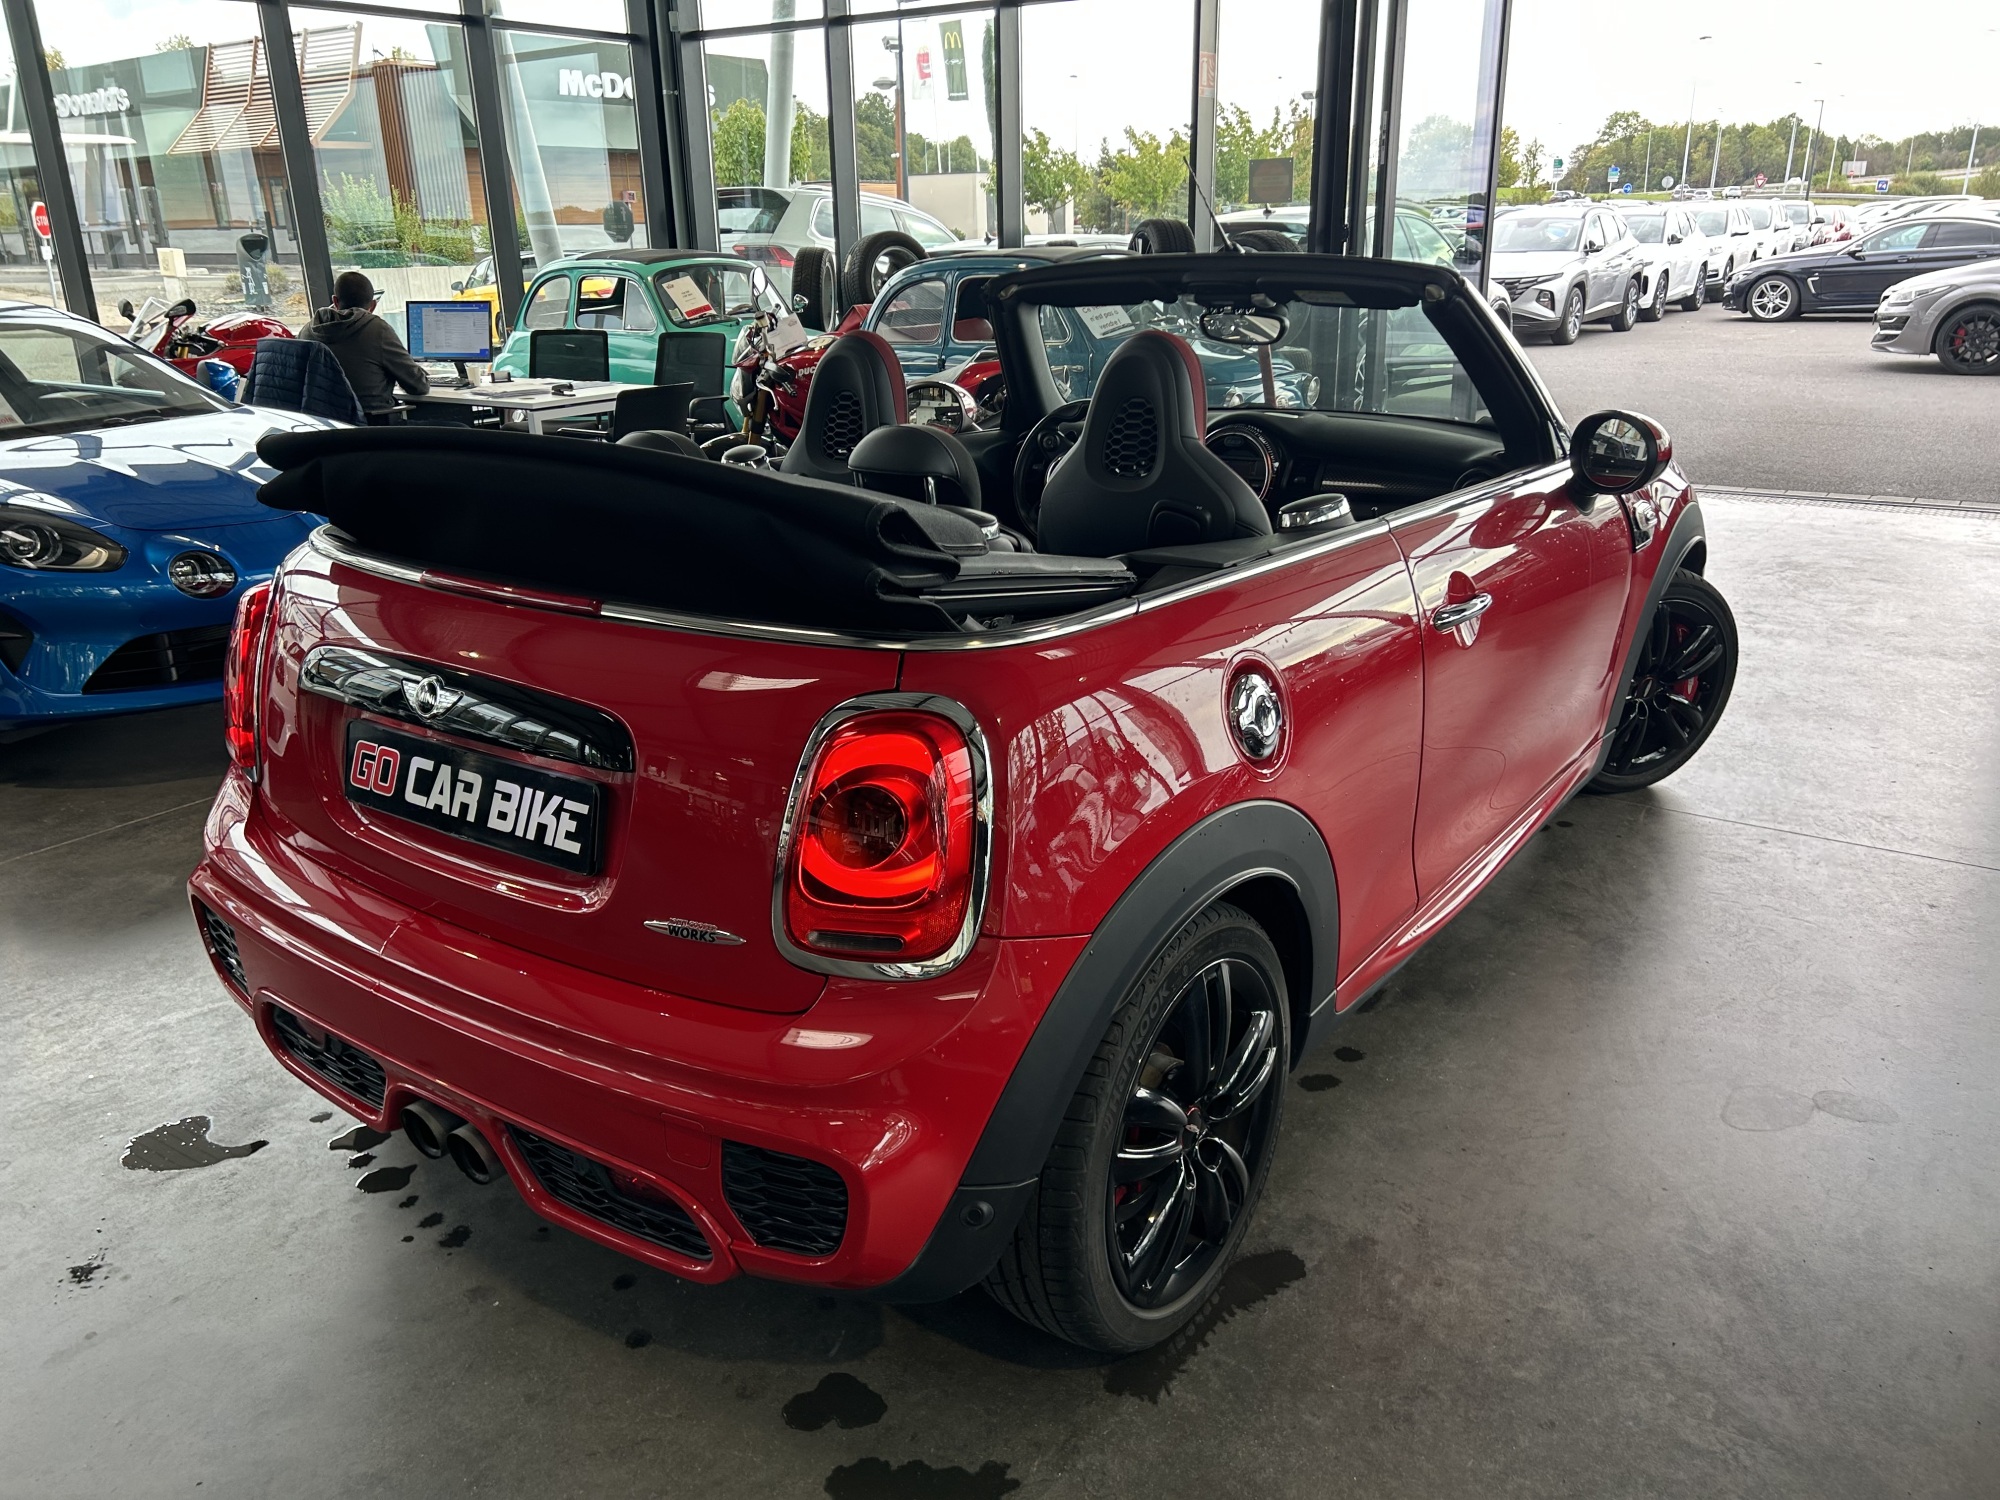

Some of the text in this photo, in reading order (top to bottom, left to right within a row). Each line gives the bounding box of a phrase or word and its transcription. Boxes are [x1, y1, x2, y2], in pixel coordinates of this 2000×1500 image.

[53, 86, 131, 118] Donald's
[36, 215, 49, 227] STO
[798, 366, 817, 377] DUC
[350, 739, 590, 855] GO CAR BIKE
[667, 925, 717, 943] WORKS
